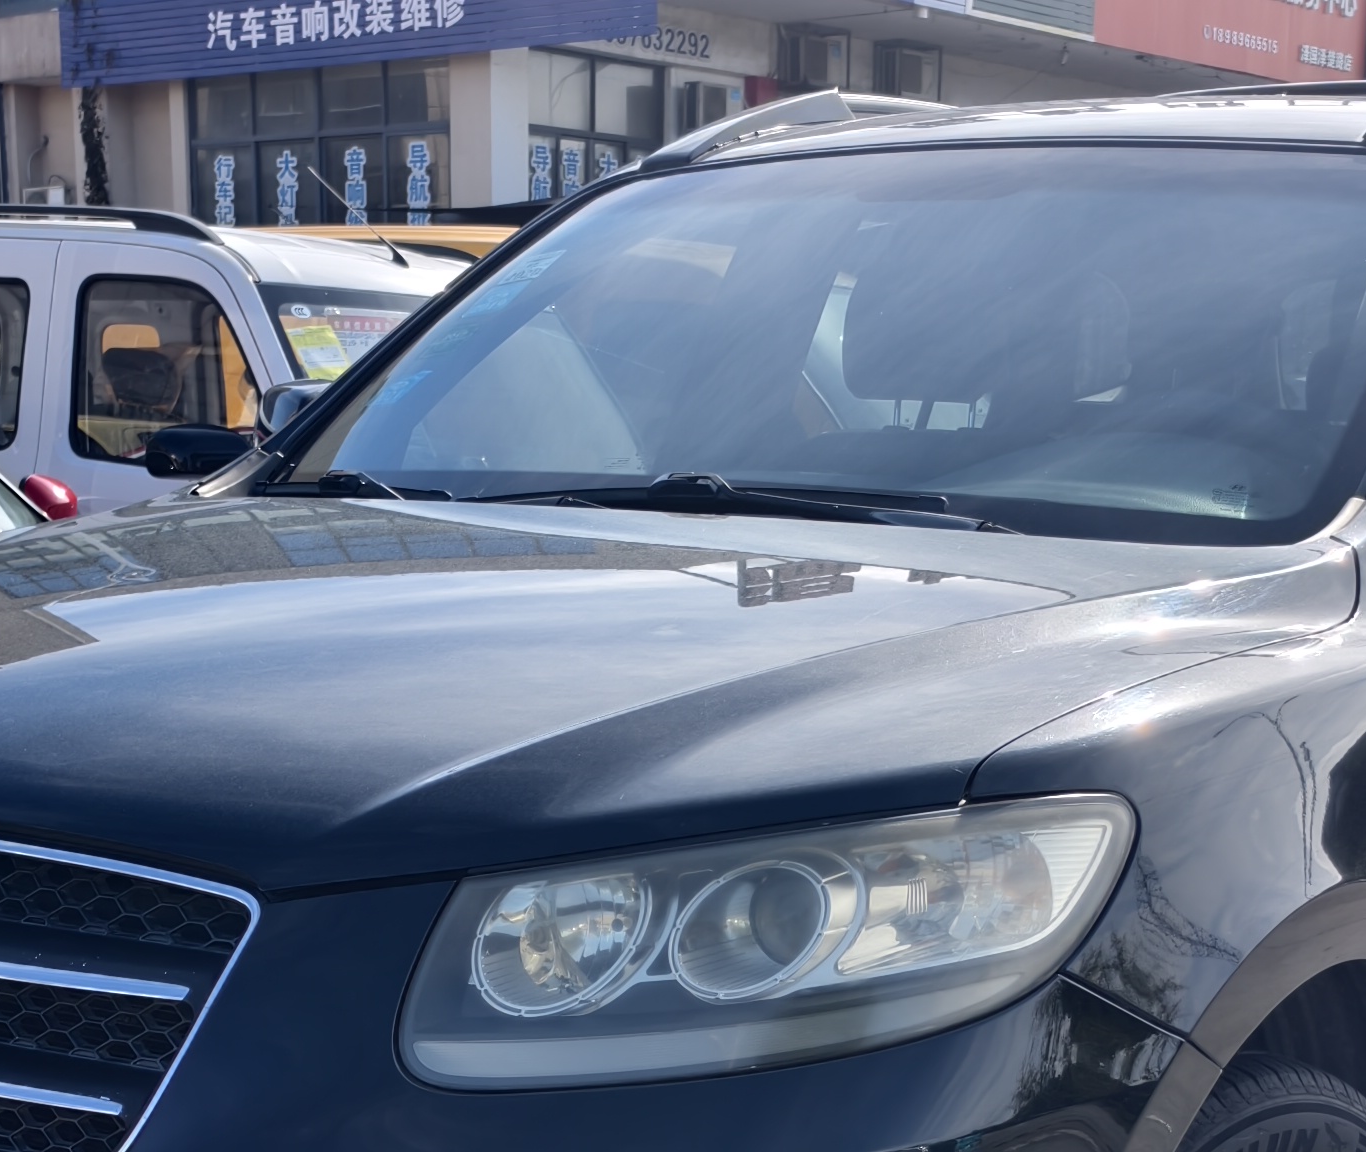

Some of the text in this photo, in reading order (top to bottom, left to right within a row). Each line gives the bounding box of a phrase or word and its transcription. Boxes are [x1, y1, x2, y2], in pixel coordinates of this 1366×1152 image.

[206, 0, 465, 50] 汽车音响改装维修
